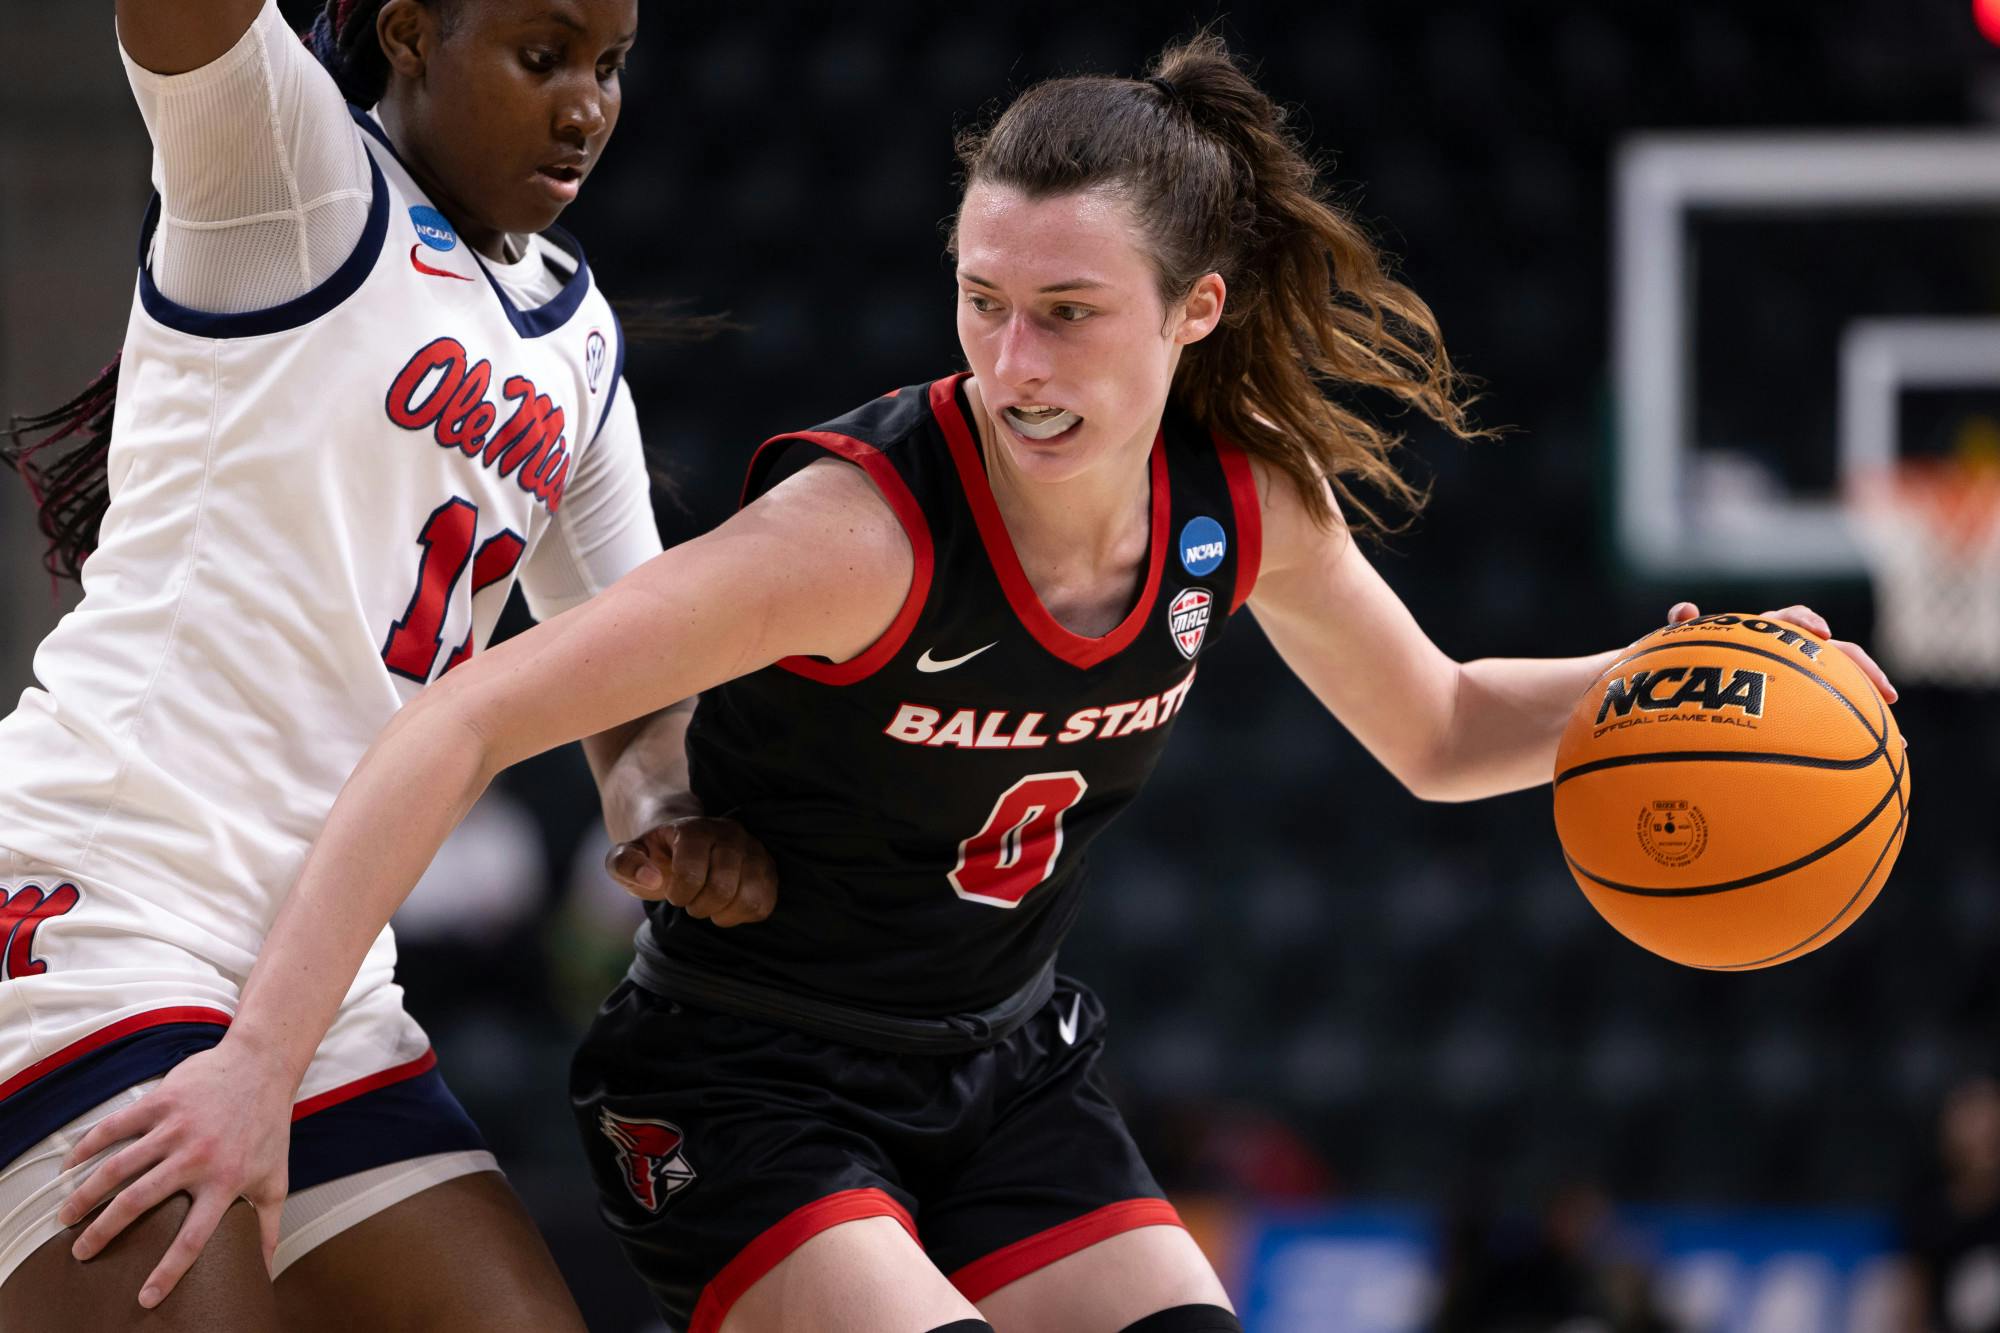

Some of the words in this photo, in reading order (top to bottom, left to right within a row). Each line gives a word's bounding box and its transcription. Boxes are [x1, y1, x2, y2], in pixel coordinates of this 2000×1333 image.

[414, 223, 454, 244] NCAA
[385, 336, 497, 458] Ole
[1186, 541, 1224, 564] NCAA
[1173, 606, 1210, 633] MAC
[1594, 666, 1767, 727] NCAA
[882, 701, 1050, 749] BALL
[1593, 716, 1655, 739] OFFICIAL
[1657, 713, 1708, 724] GAME
[1710, 714, 1758, 730] BALL
[946, 769, 1089, 910] 0
